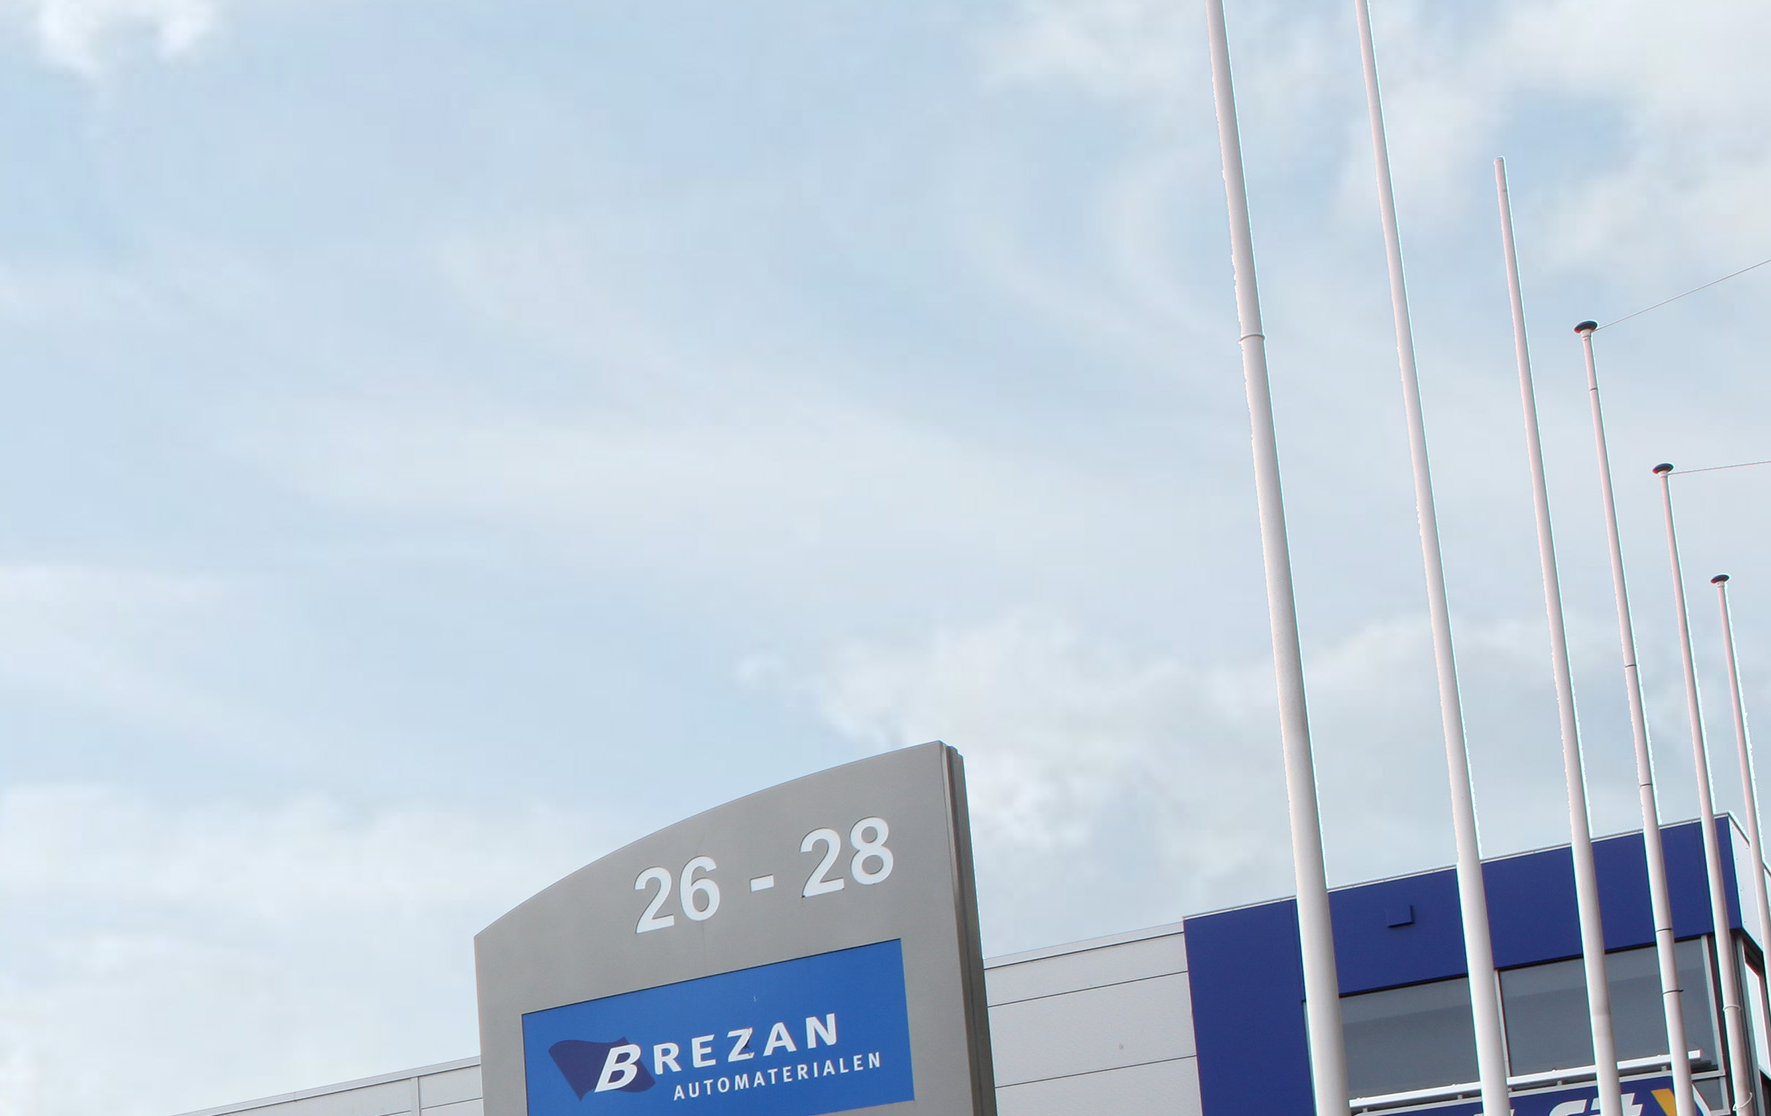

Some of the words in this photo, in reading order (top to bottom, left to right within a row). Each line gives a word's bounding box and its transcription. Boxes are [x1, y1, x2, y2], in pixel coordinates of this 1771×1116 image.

[634, 855, 721, 934] 26
[750, 874, 774, 893] -
[799, 816, 894, 898] 28
[594, 1013, 838, 1093] BREZAN
[673, 1052, 882, 1102] AUTOMATERIALEN
